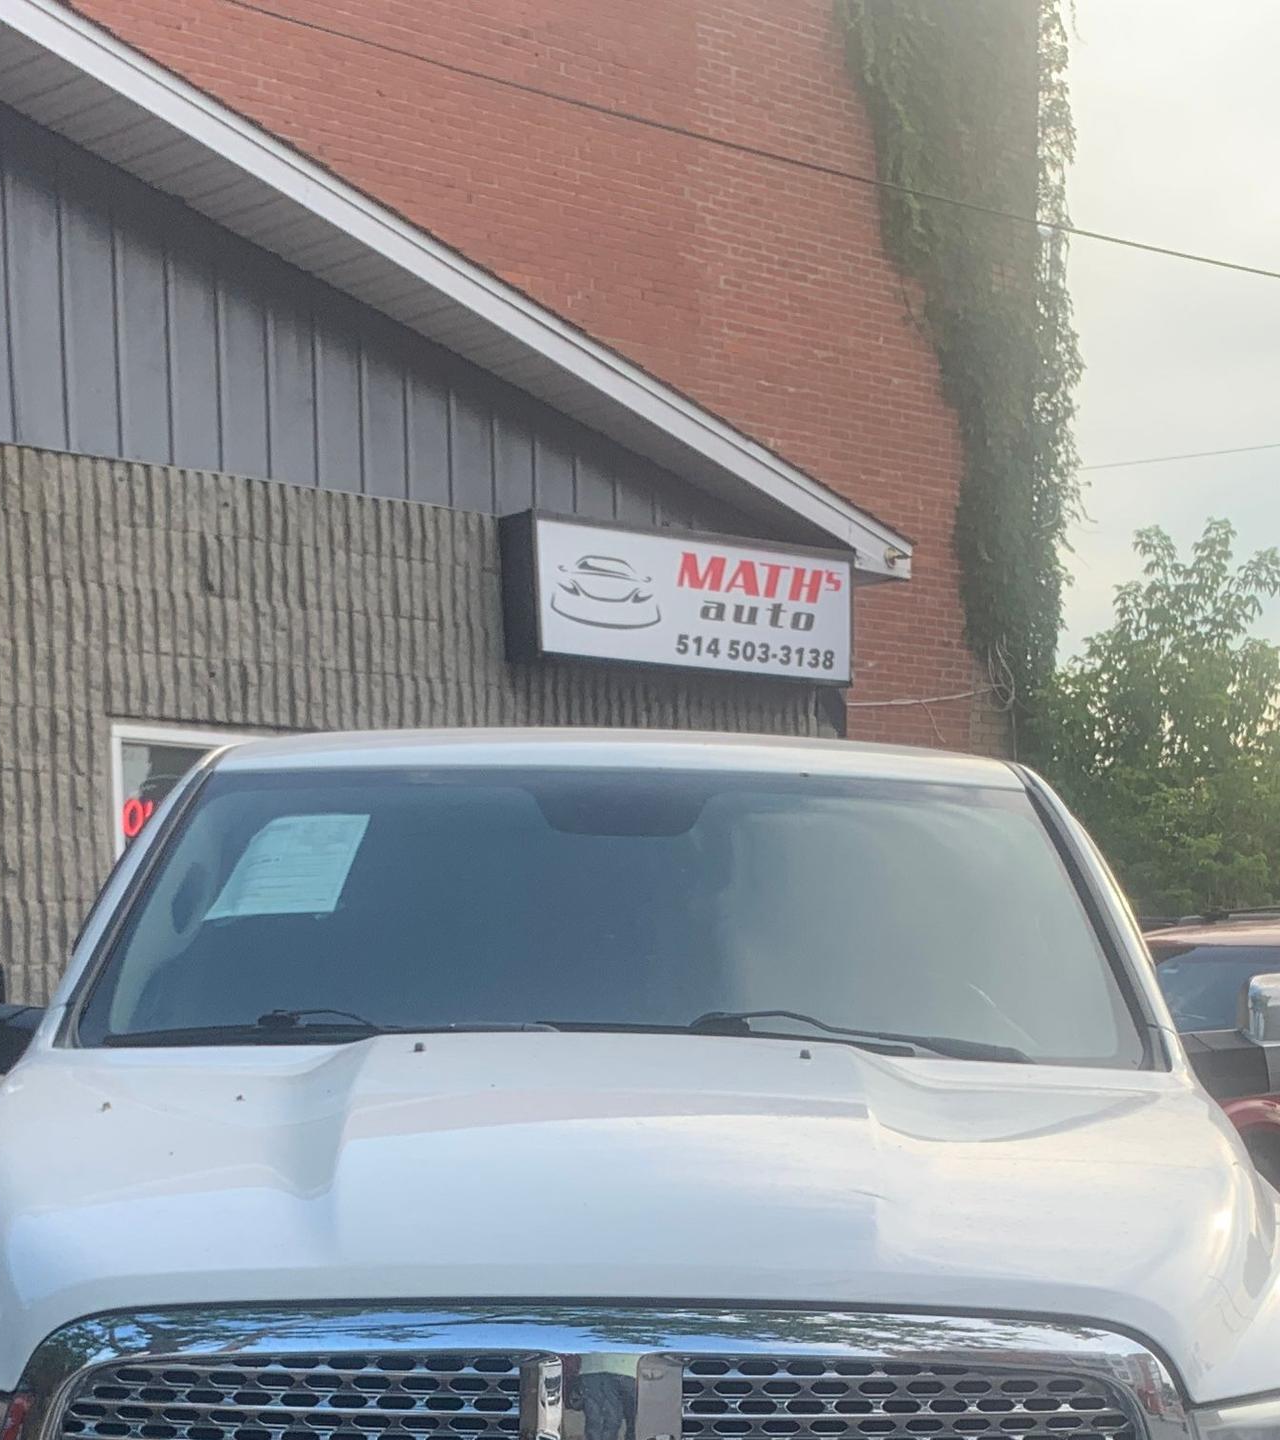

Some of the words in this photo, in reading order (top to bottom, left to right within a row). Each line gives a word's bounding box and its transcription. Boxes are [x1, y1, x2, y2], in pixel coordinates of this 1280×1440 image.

[700, 600, 815, 632] auto
[676, 633, 721, 658] 514
[727, 639, 835, 670] 503-3138
